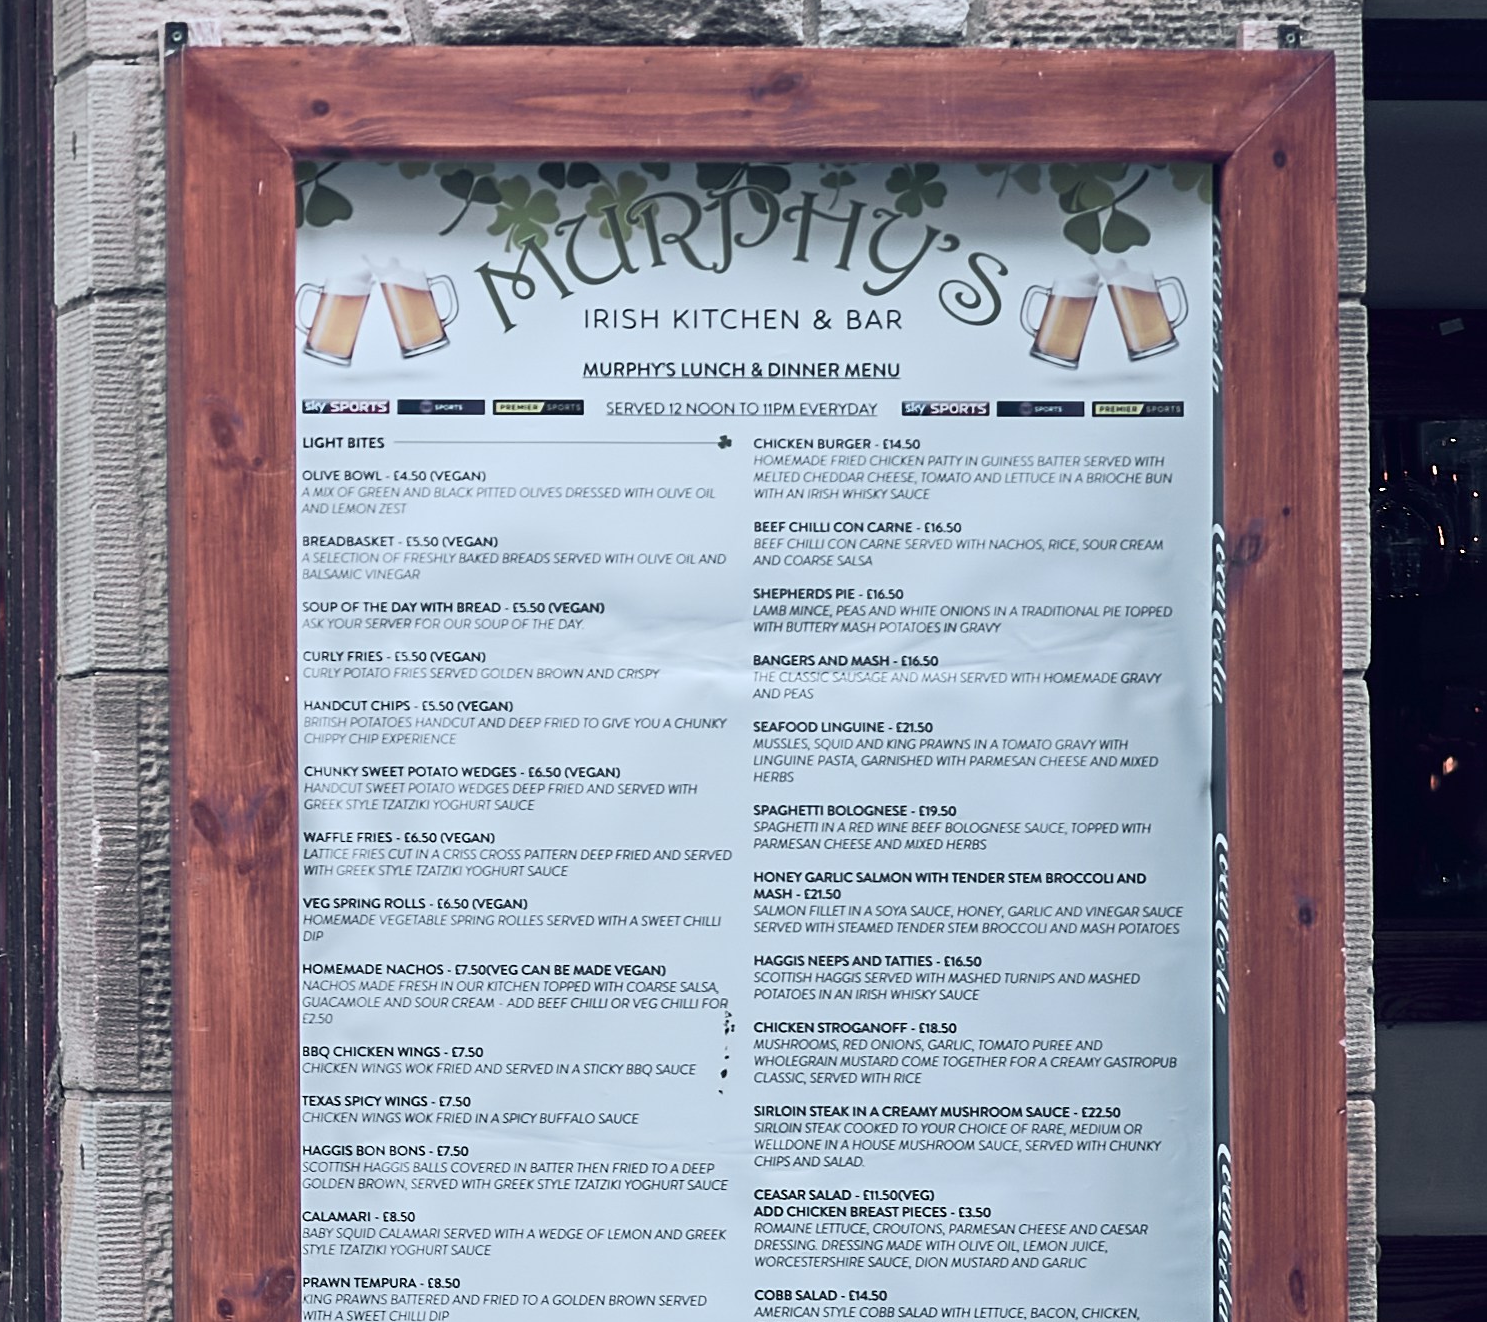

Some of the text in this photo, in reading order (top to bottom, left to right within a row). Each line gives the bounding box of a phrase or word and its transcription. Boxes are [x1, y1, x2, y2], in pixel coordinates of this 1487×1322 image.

[474, 184, 1009, 333] MURPHY'S
[584, 308, 903, 331] IRISH KITCHEN & BAR
[582, 361, 900, 377] MURPHY'S LUNCH & DINNER MENU
[329, 401, 389, 414] SPORTS
[499, 403, 540, 412] PREMIER
[606, 401, 878, 415] SERVED 12 NOON TO 11PM EVERYDAY
[930, 402, 988, 415] SPORTS
[1098, 404, 1139, 414] PREMIER
[302, 436, 386, 449] LIGHT BITES
[753, 437, 921, 450] CHICKEN BURGER £14.50
[301, 469, 487, 483] OLIVE BOWL £4.50 (VEGAN)
[752, 654, 940, 668] BANGERS AND MASH £16.50
[753, 804, 958, 817] SPAGHETTI BOLOGNESE £19.50
[302, 831, 496, 845] WAFFLE FRIES £6.50 (VEGAN)
[753, 1021, 958, 1034] CHICKEN STROGANOFF £18.50
[301, 1210, 416, 1223] CALAMARI £8.50
[753, 1289, 888, 1302] COBB SALAD £14.50
